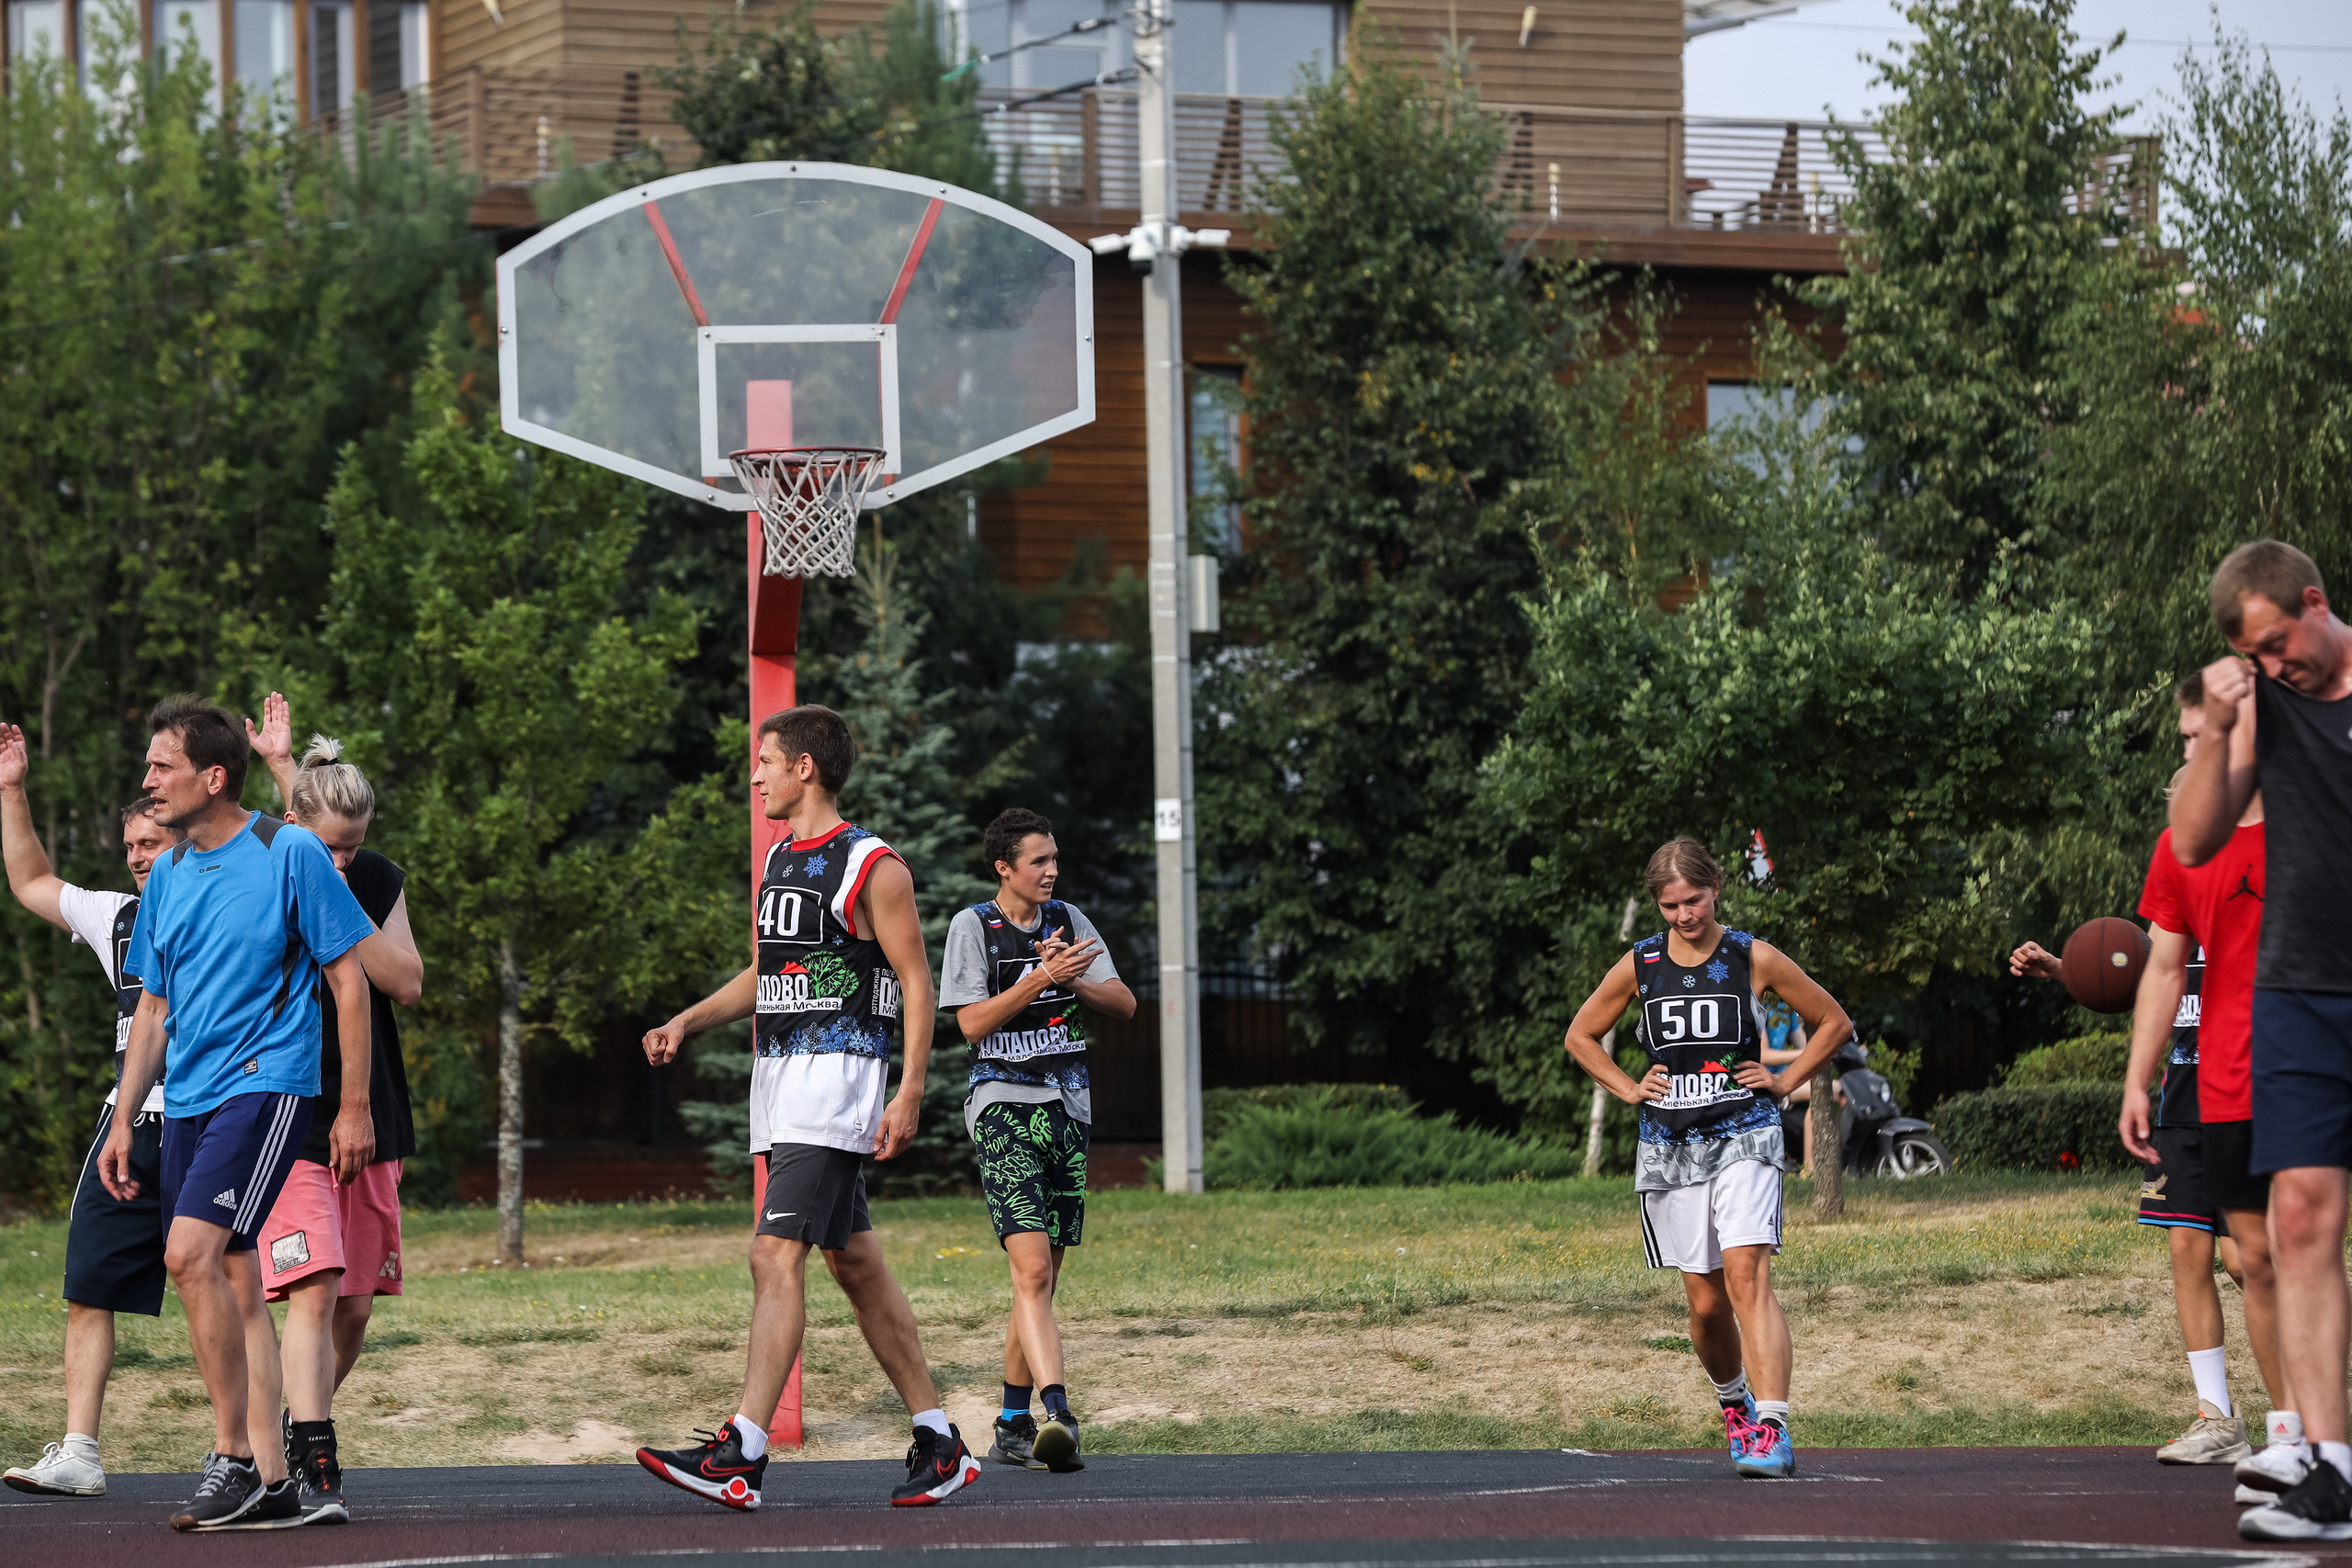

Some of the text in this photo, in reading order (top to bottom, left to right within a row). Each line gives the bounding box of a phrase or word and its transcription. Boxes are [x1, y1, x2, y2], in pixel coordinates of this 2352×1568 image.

[1156, 810, 1181, 827] 15
[758, 892, 802, 936] 40
[882, 968, 896, 978] посе
[793, 1000, 840, 1010] Москва
[1661, 999, 1719, 1040] 50
[213, 1197, 237, 1211] adidas
